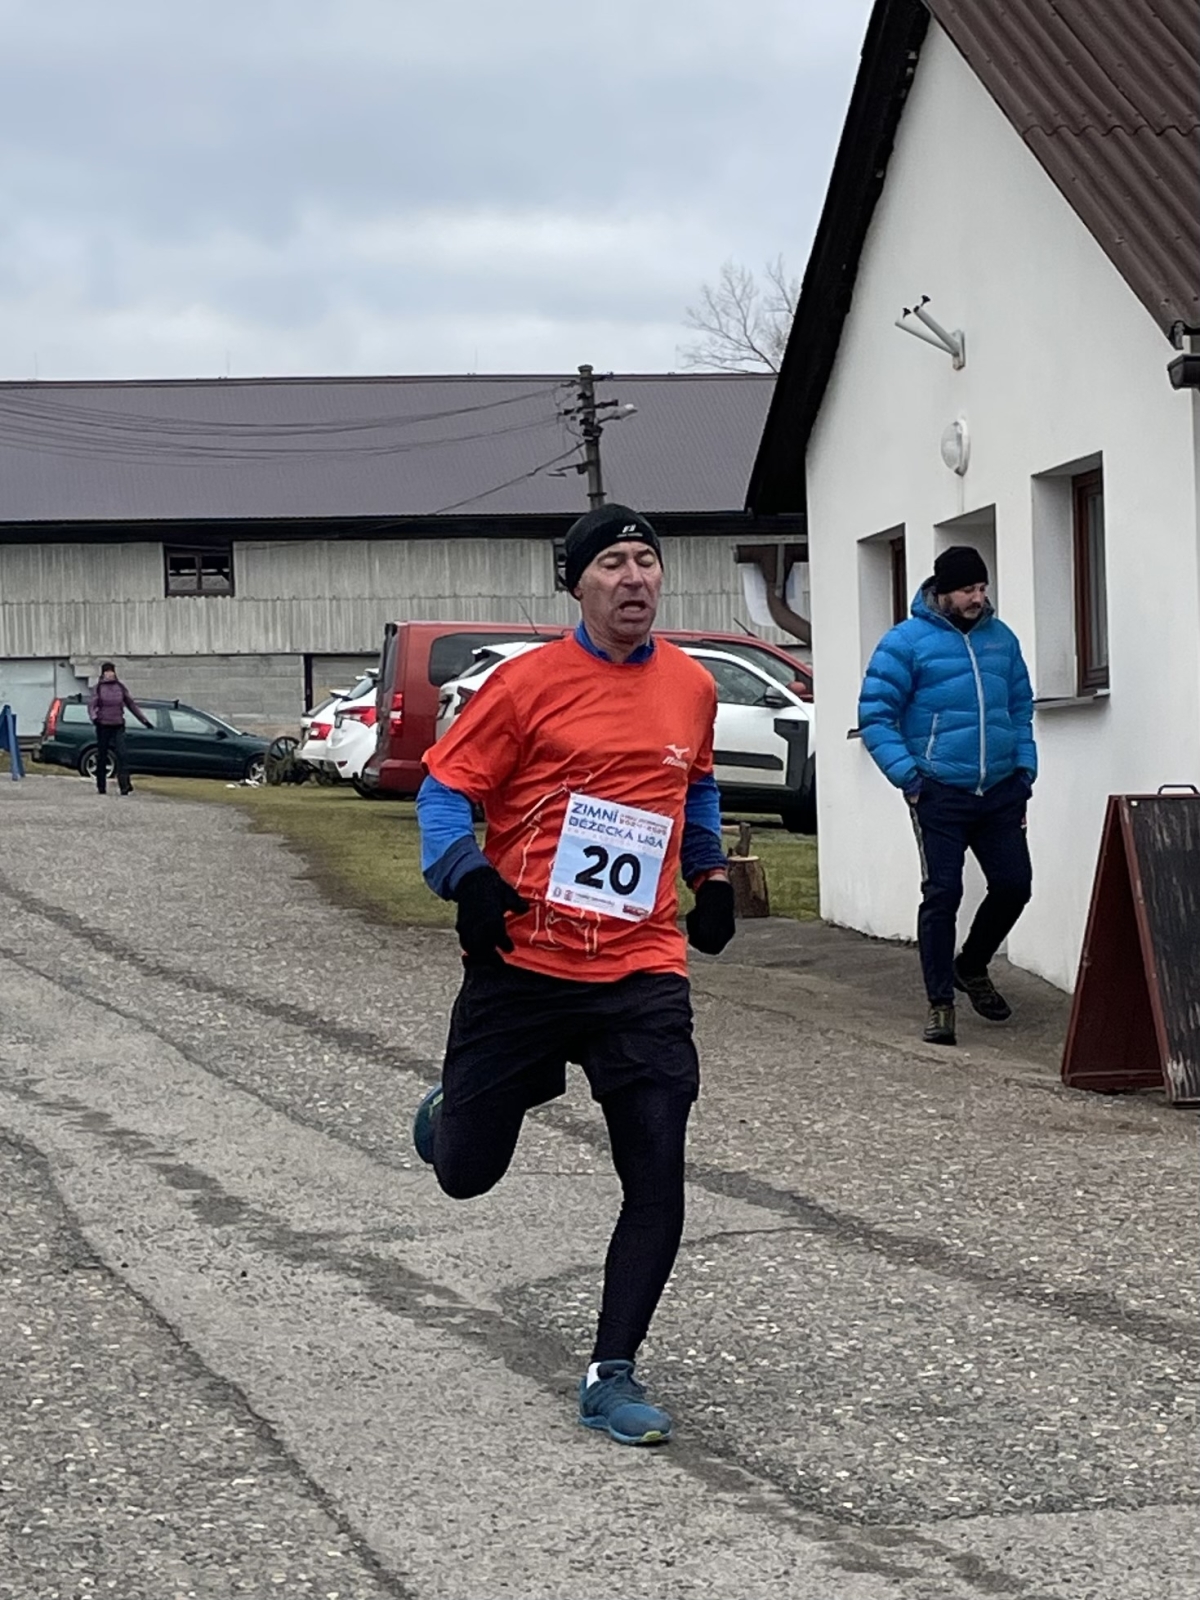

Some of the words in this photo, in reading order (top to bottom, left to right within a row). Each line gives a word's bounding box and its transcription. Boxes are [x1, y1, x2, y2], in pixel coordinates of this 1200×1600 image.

[571, 801, 619, 823] ZIMNÍ
[637, 833, 664, 849] LIGA
[574, 845, 641, 896] 20
